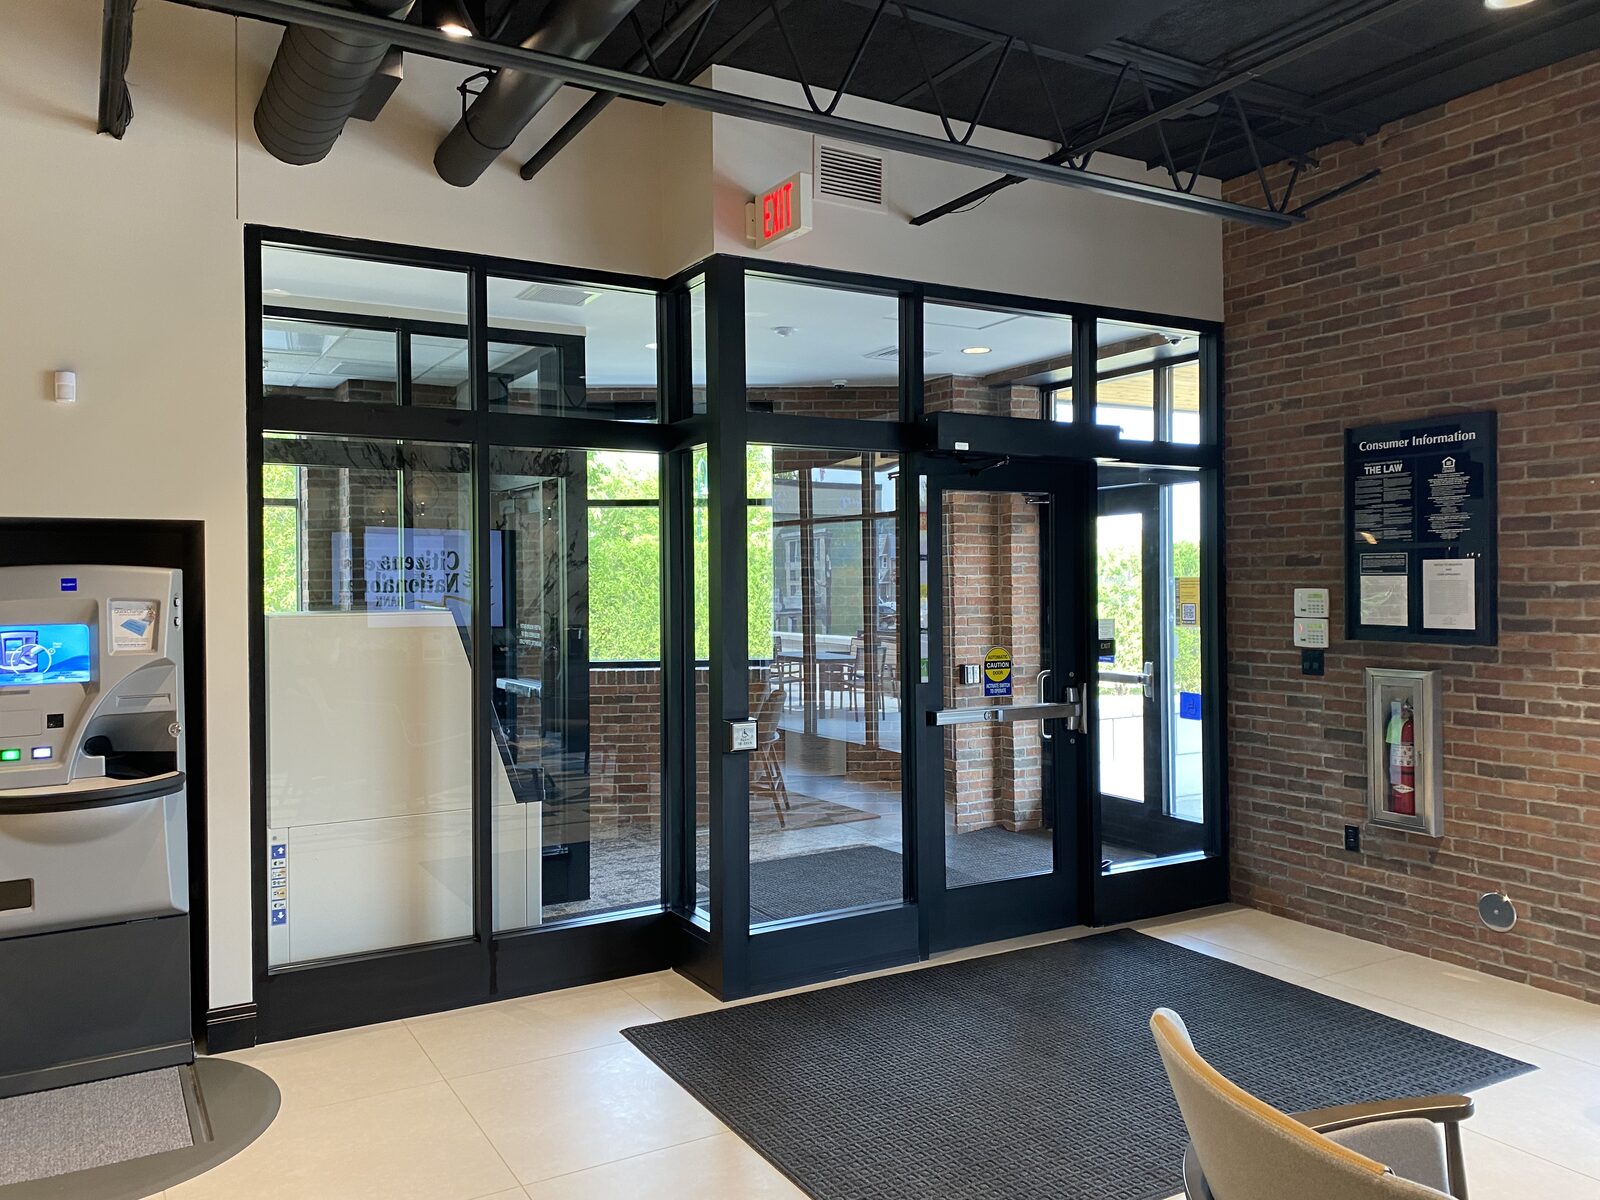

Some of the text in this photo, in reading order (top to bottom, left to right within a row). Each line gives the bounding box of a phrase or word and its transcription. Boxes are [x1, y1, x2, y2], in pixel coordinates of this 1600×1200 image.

[763, 182, 793, 240] EXIT
[1359, 430, 1477, 452] Consumer Information
[1364, 464, 1403, 475] THE LAW
